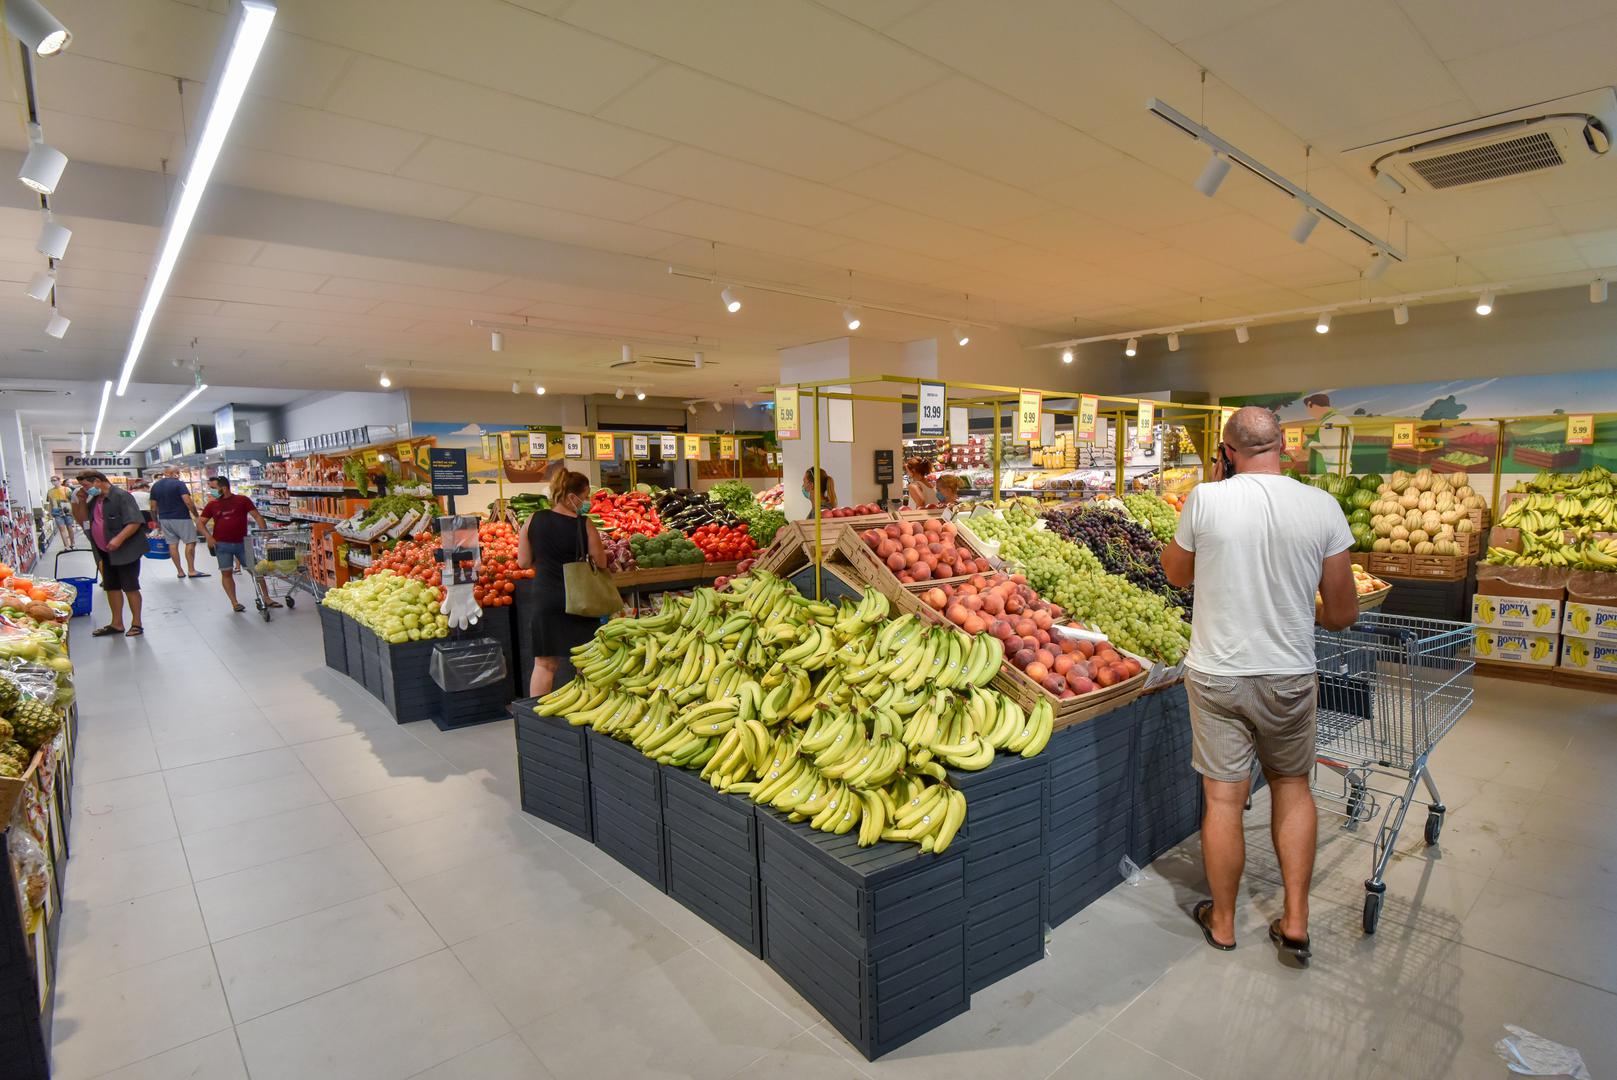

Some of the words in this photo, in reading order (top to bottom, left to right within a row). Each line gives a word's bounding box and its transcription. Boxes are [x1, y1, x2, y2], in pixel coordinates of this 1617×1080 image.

[65, 455, 131, 466] Pekarnica
[1499, 603, 1529, 617] BONITA
[1497, 635, 1528, 649] BONITA
